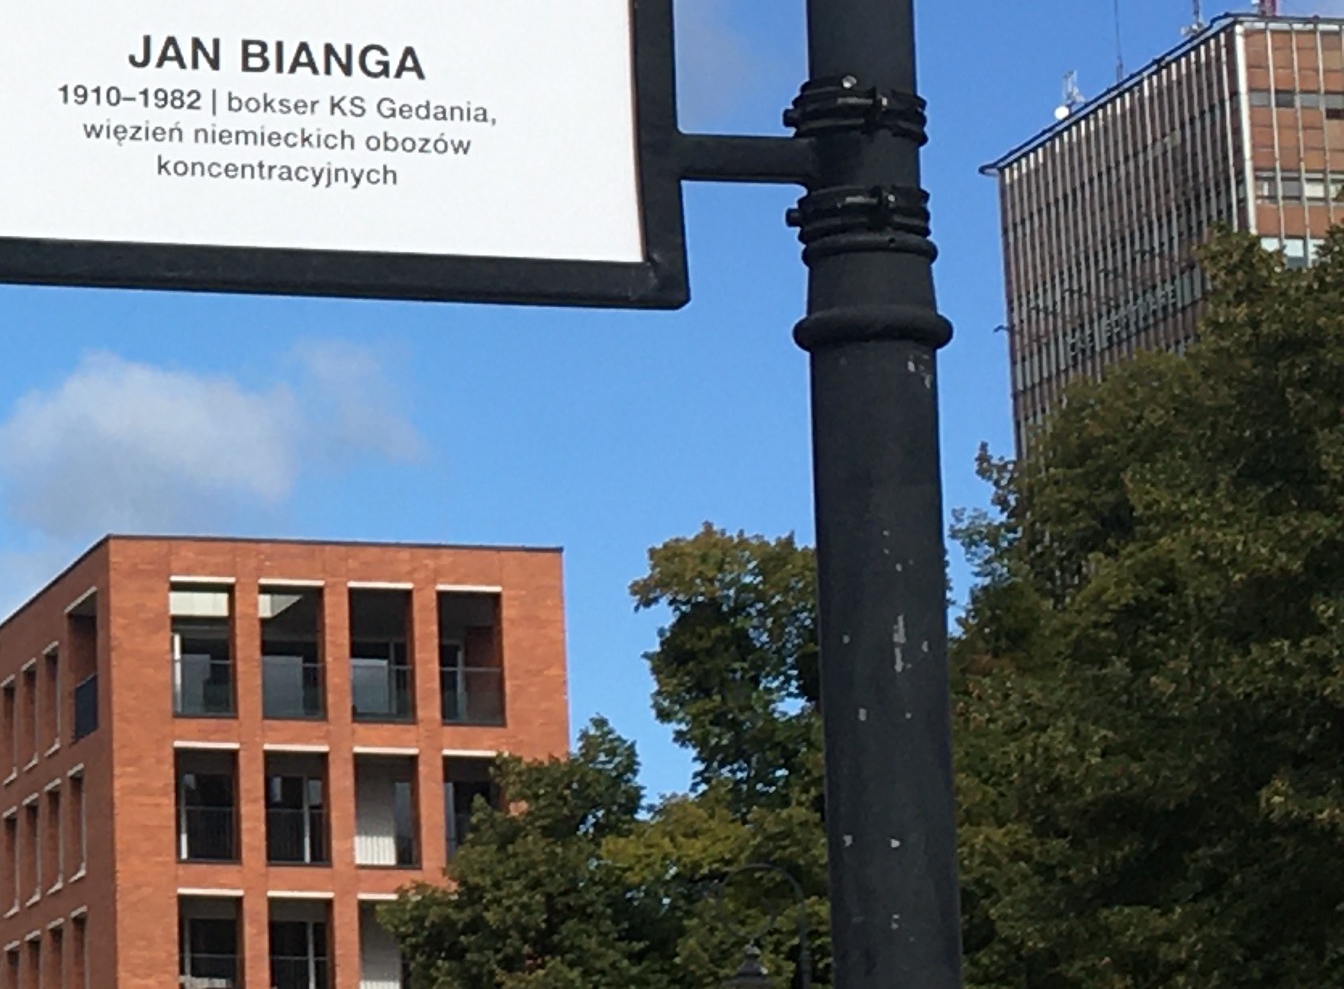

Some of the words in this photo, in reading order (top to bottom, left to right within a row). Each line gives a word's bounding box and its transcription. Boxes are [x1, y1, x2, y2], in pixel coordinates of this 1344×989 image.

[128, 34, 221, 72] JAN
[241, 38, 426, 81] BIANGA
[228, 91, 320, 115] bokser
[330, 95, 367, 118] KS
[376, 97, 497, 126] Gedania,
[83, 120, 184, 147] więzień
[194, 126, 355, 151] niemieckich
[365, 135, 472, 156] obozów
[157, 154, 398, 190] koncentracyjnych
